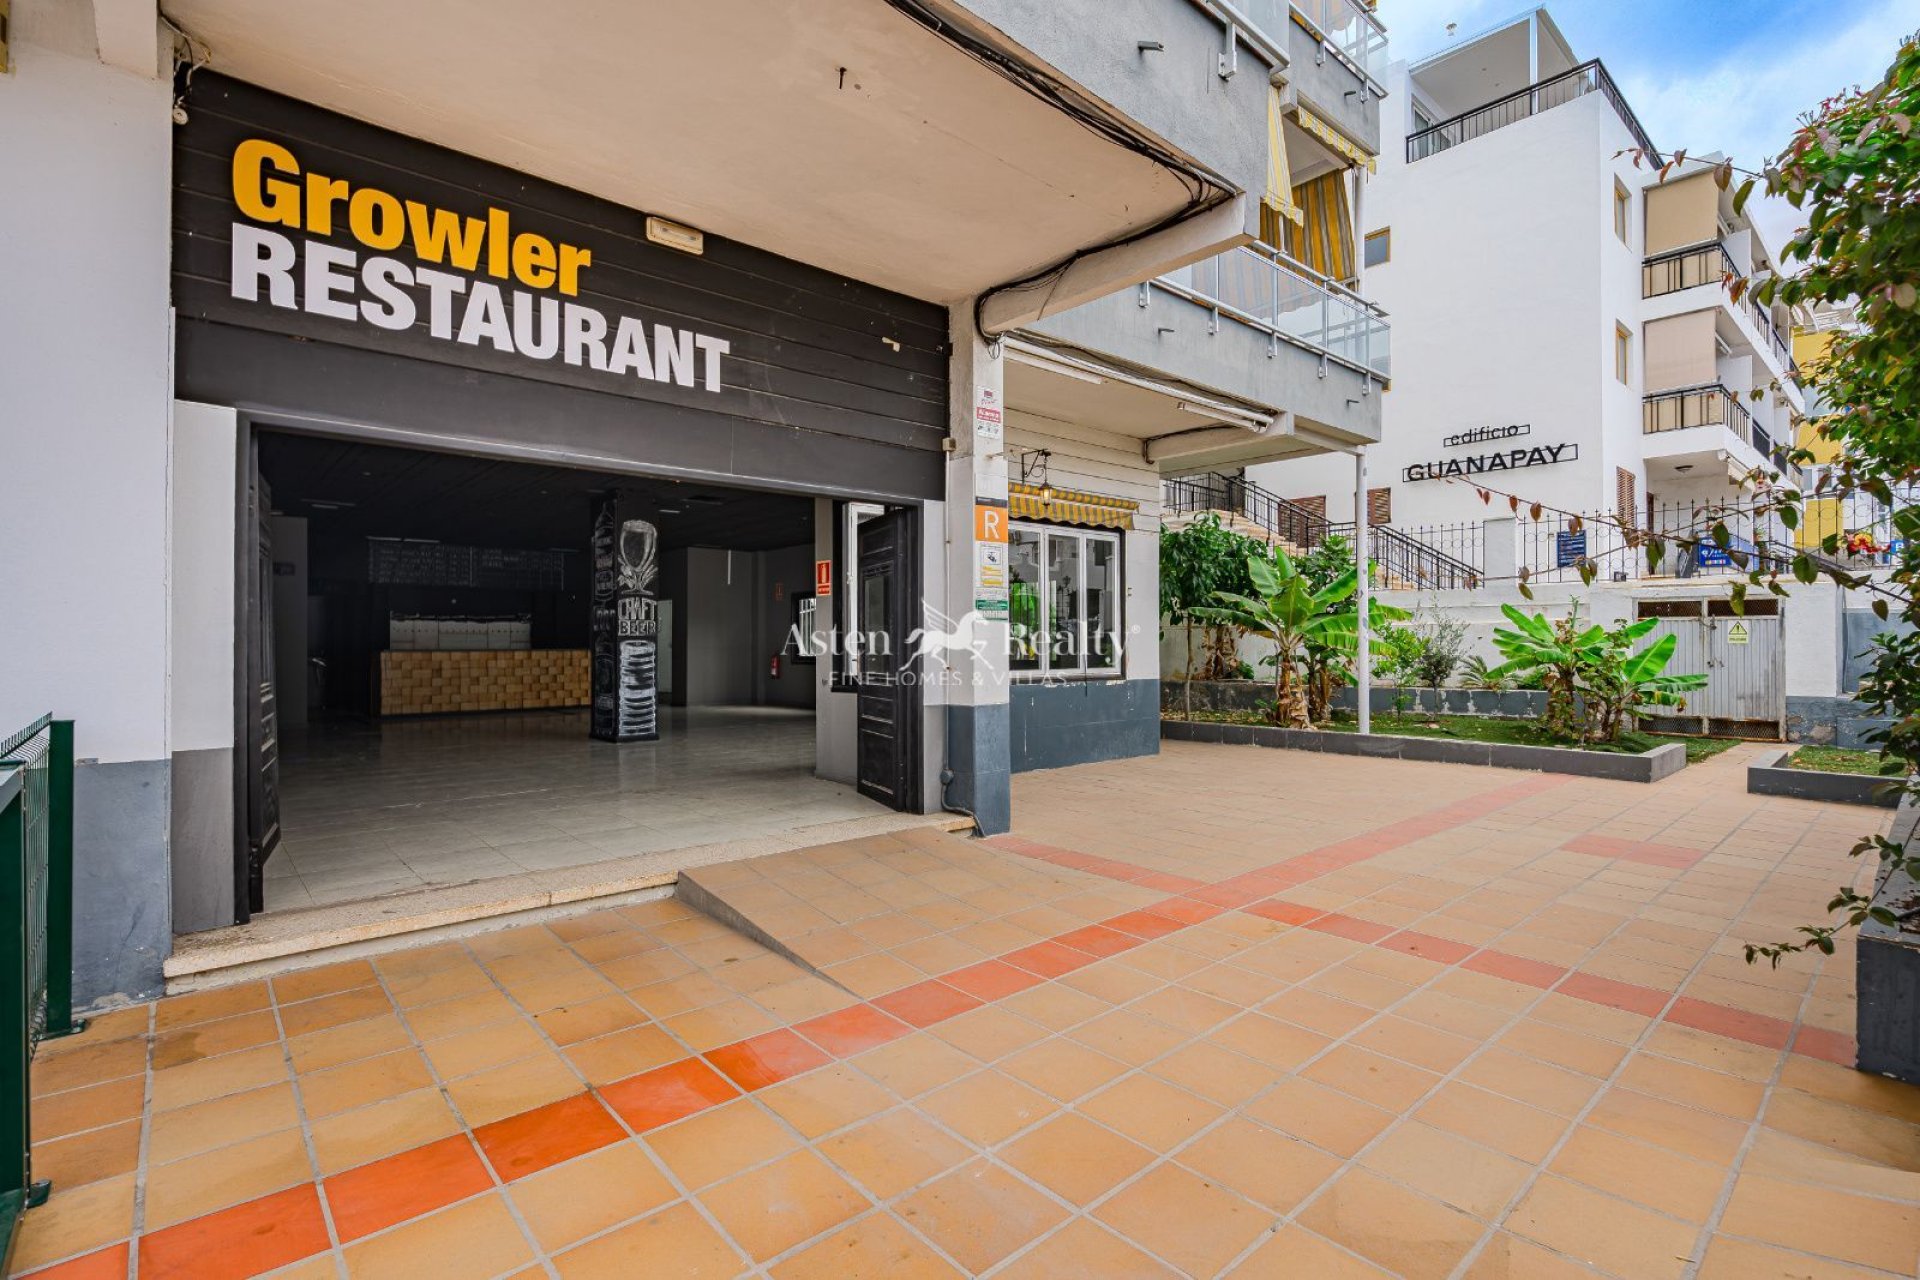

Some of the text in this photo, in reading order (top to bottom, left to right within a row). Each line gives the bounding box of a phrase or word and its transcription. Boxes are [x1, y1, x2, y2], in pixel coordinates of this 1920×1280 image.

[232, 138, 591, 296] Growler
[231, 222, 731, 393] RESTAURANT
[1450, 424, 1519, 446] edificio
[1407, 443, 1566, 482] GUANAPAY
[984, 510, 1000, 540] R
[618, 597, 657, 620] CRAFT
[618, 620, 656, 637] BEER
